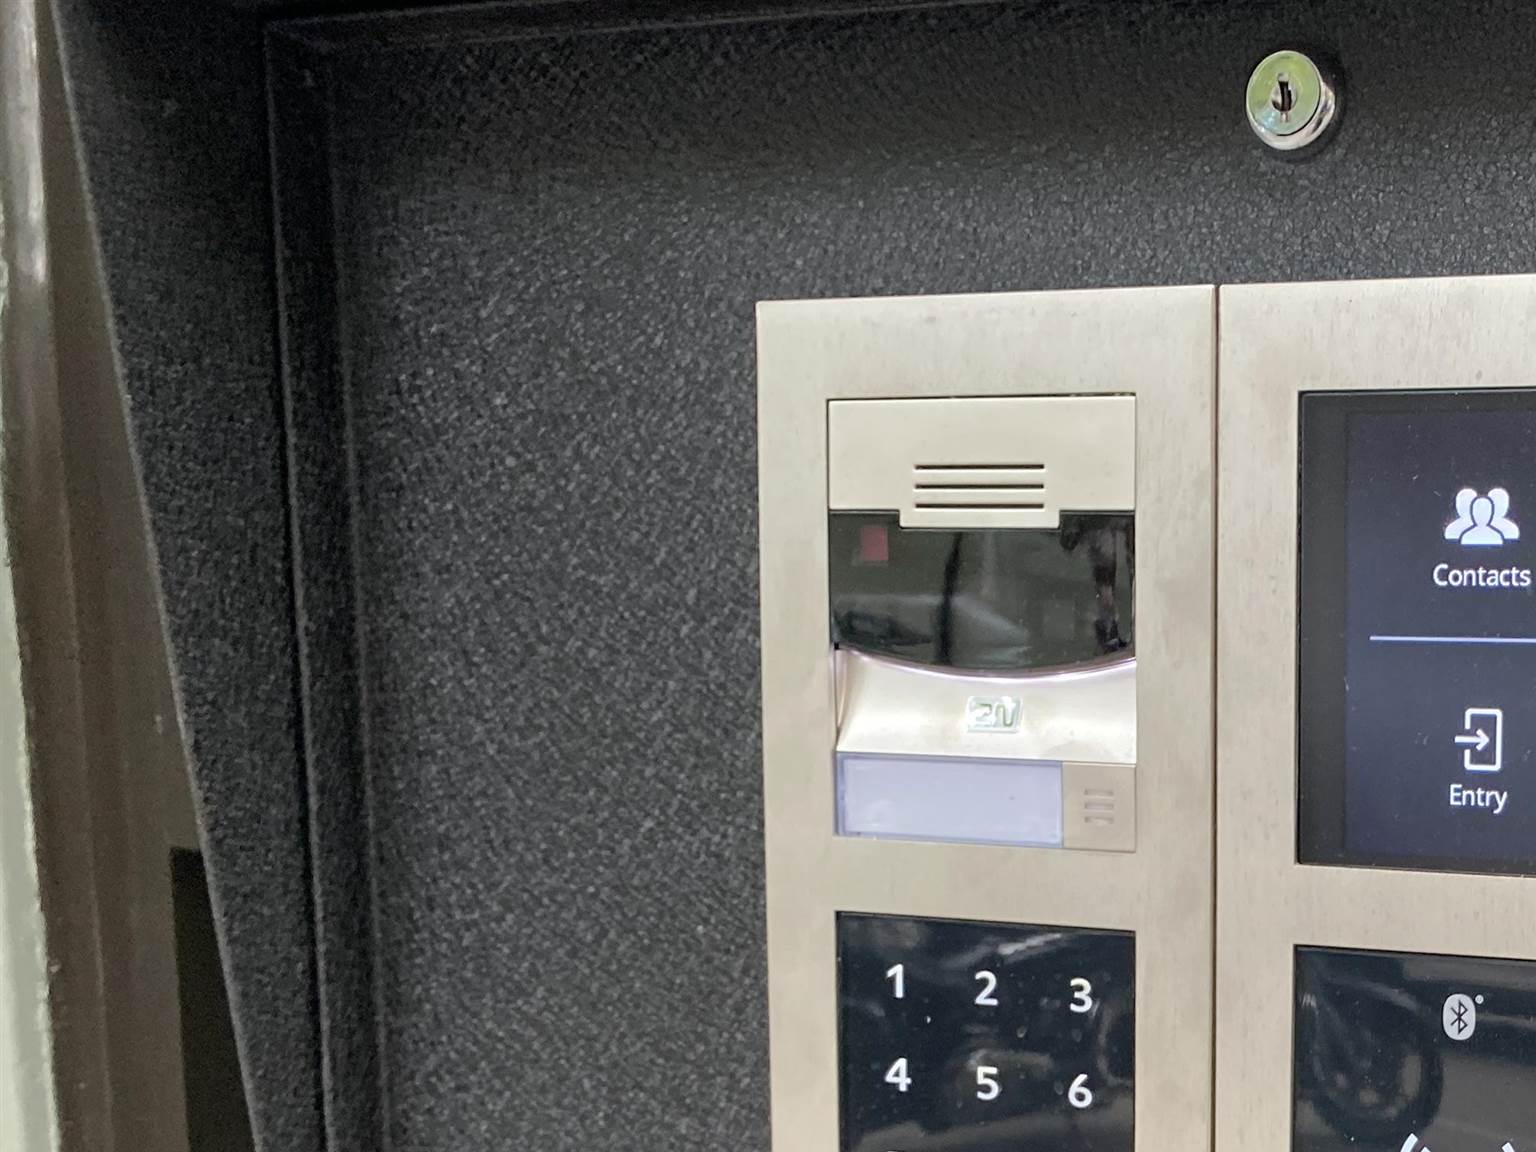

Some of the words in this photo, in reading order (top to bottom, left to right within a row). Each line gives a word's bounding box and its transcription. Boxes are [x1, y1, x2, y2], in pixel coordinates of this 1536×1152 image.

[1432, 563, 1532, 588] Contacts
[1449, 783, 1508, 814] Entry
[886, 963, 904, 999] 1
[973, 970, 999, 1006] 2
[1068, 977, 1093, 1014] 3
[885, 1057, 912, 1092] 4
[976, 1066, 999, 1101] 5
[1067, 1074, 1093, 1109] 6
